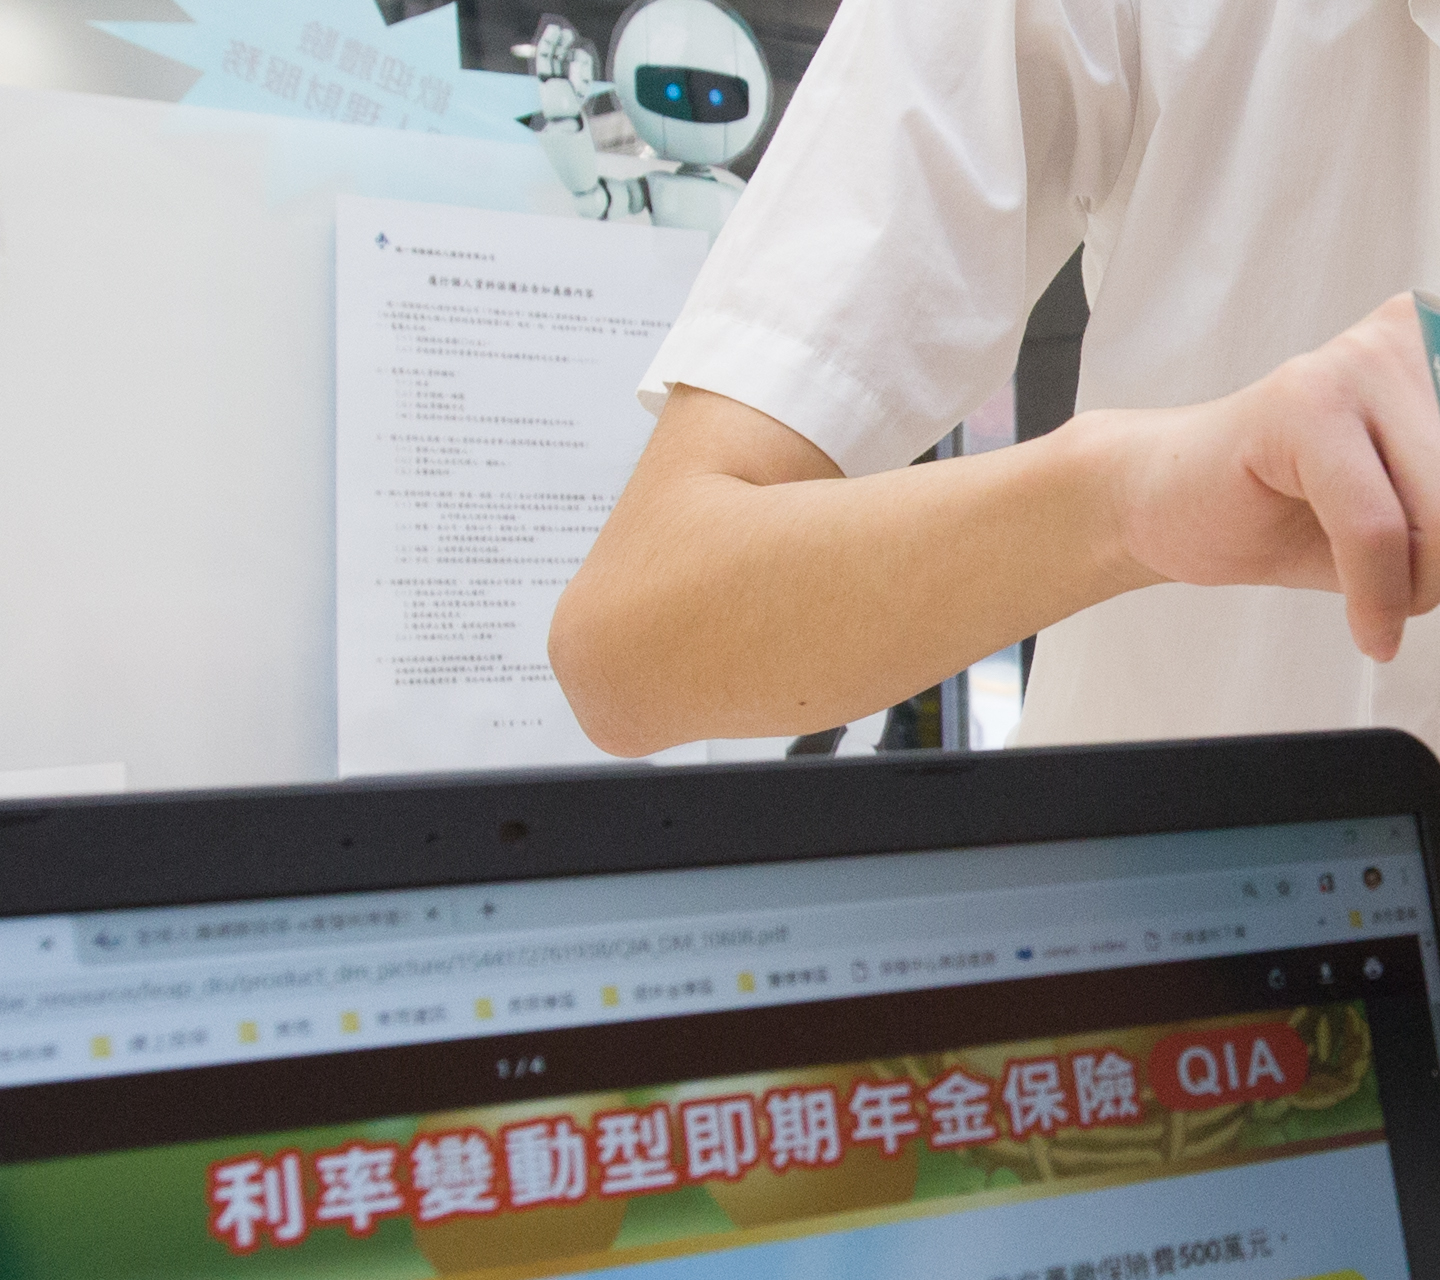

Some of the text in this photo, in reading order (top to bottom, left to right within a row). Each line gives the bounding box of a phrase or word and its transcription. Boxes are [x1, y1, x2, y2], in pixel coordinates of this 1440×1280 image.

[212, 1048, 1140, 1247] 利率變動型即期年金保險
[1177, 1037, 1288, 1099] QIA
